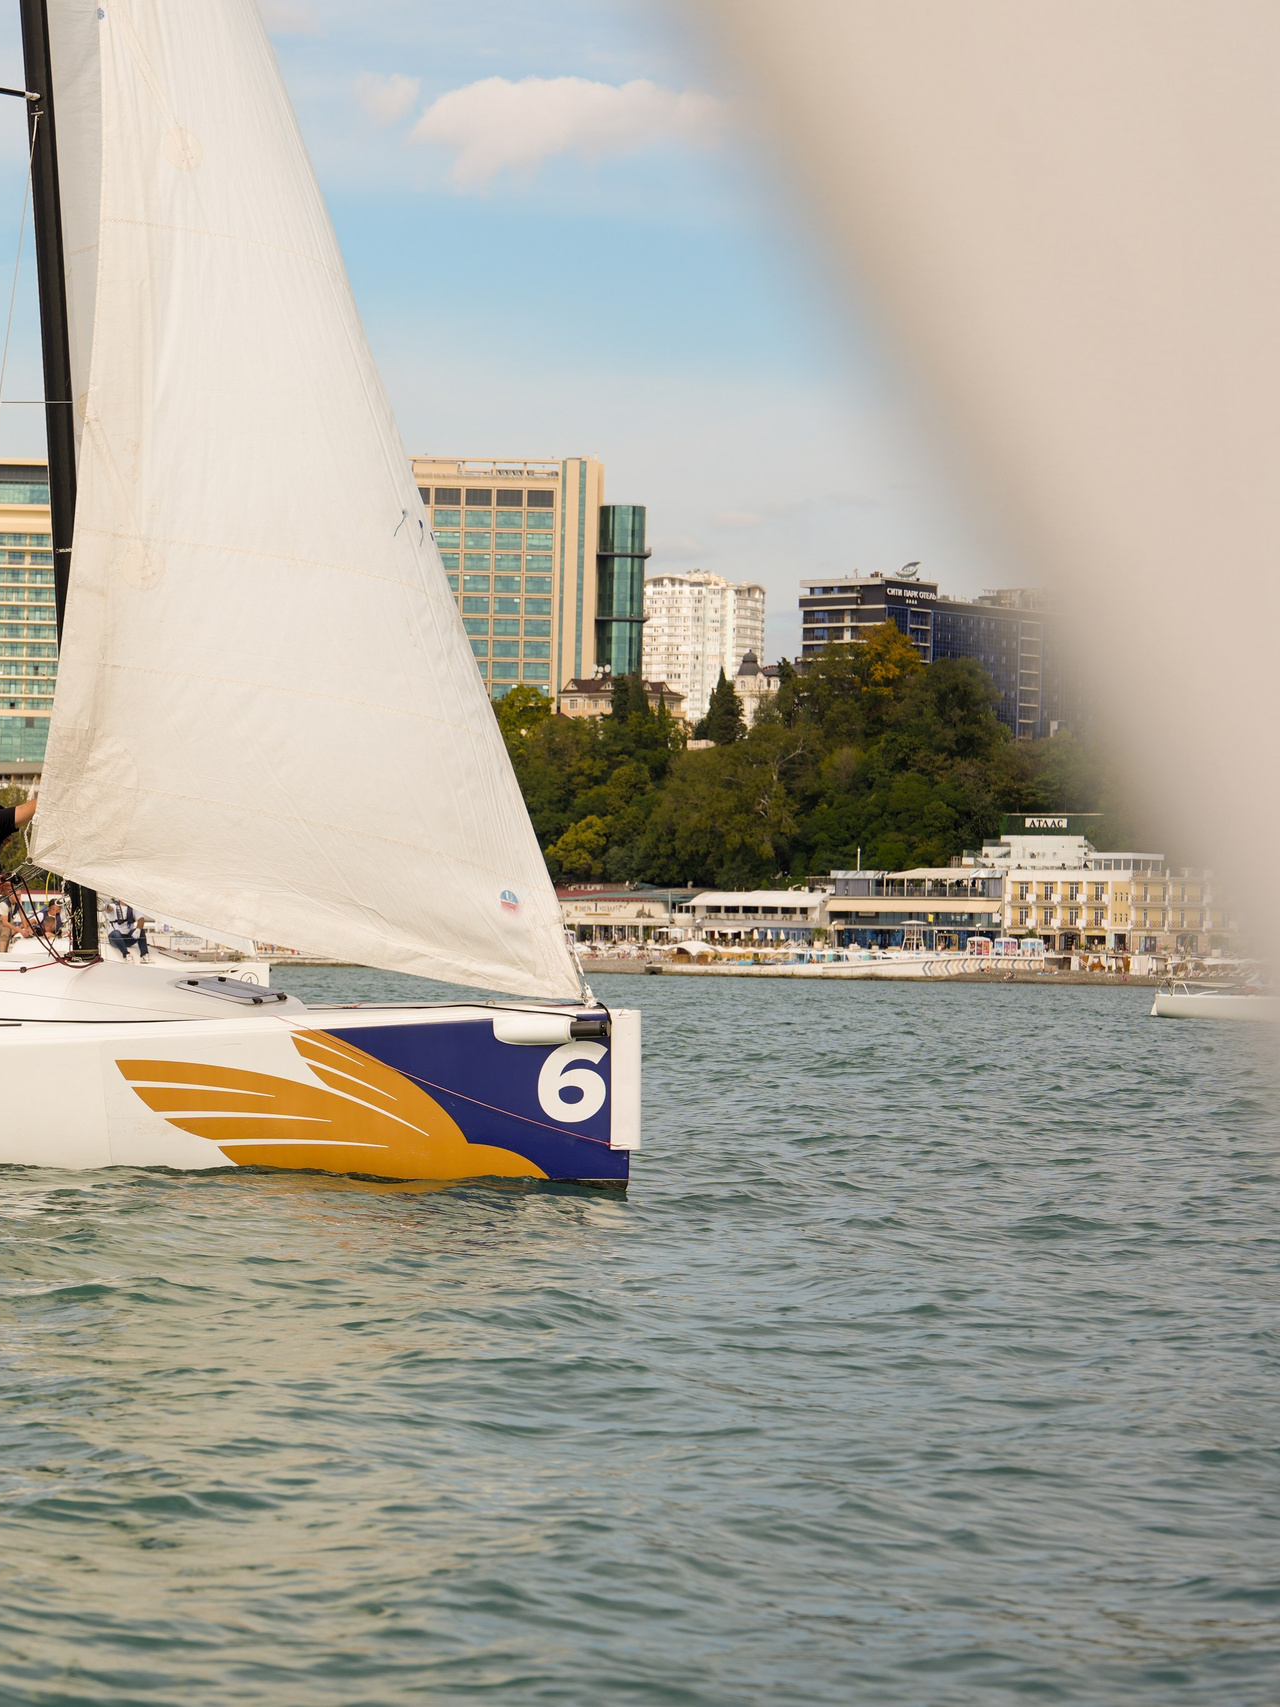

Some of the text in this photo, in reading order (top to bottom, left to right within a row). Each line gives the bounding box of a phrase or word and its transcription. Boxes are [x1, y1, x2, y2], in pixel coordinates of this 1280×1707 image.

[886, 587, 937, 600] СИТИ ПАРК ОТЕЛЬ
[1030, 819, 1064, 828] АТЛАС
[538, 1041, 609, 1123] 6
